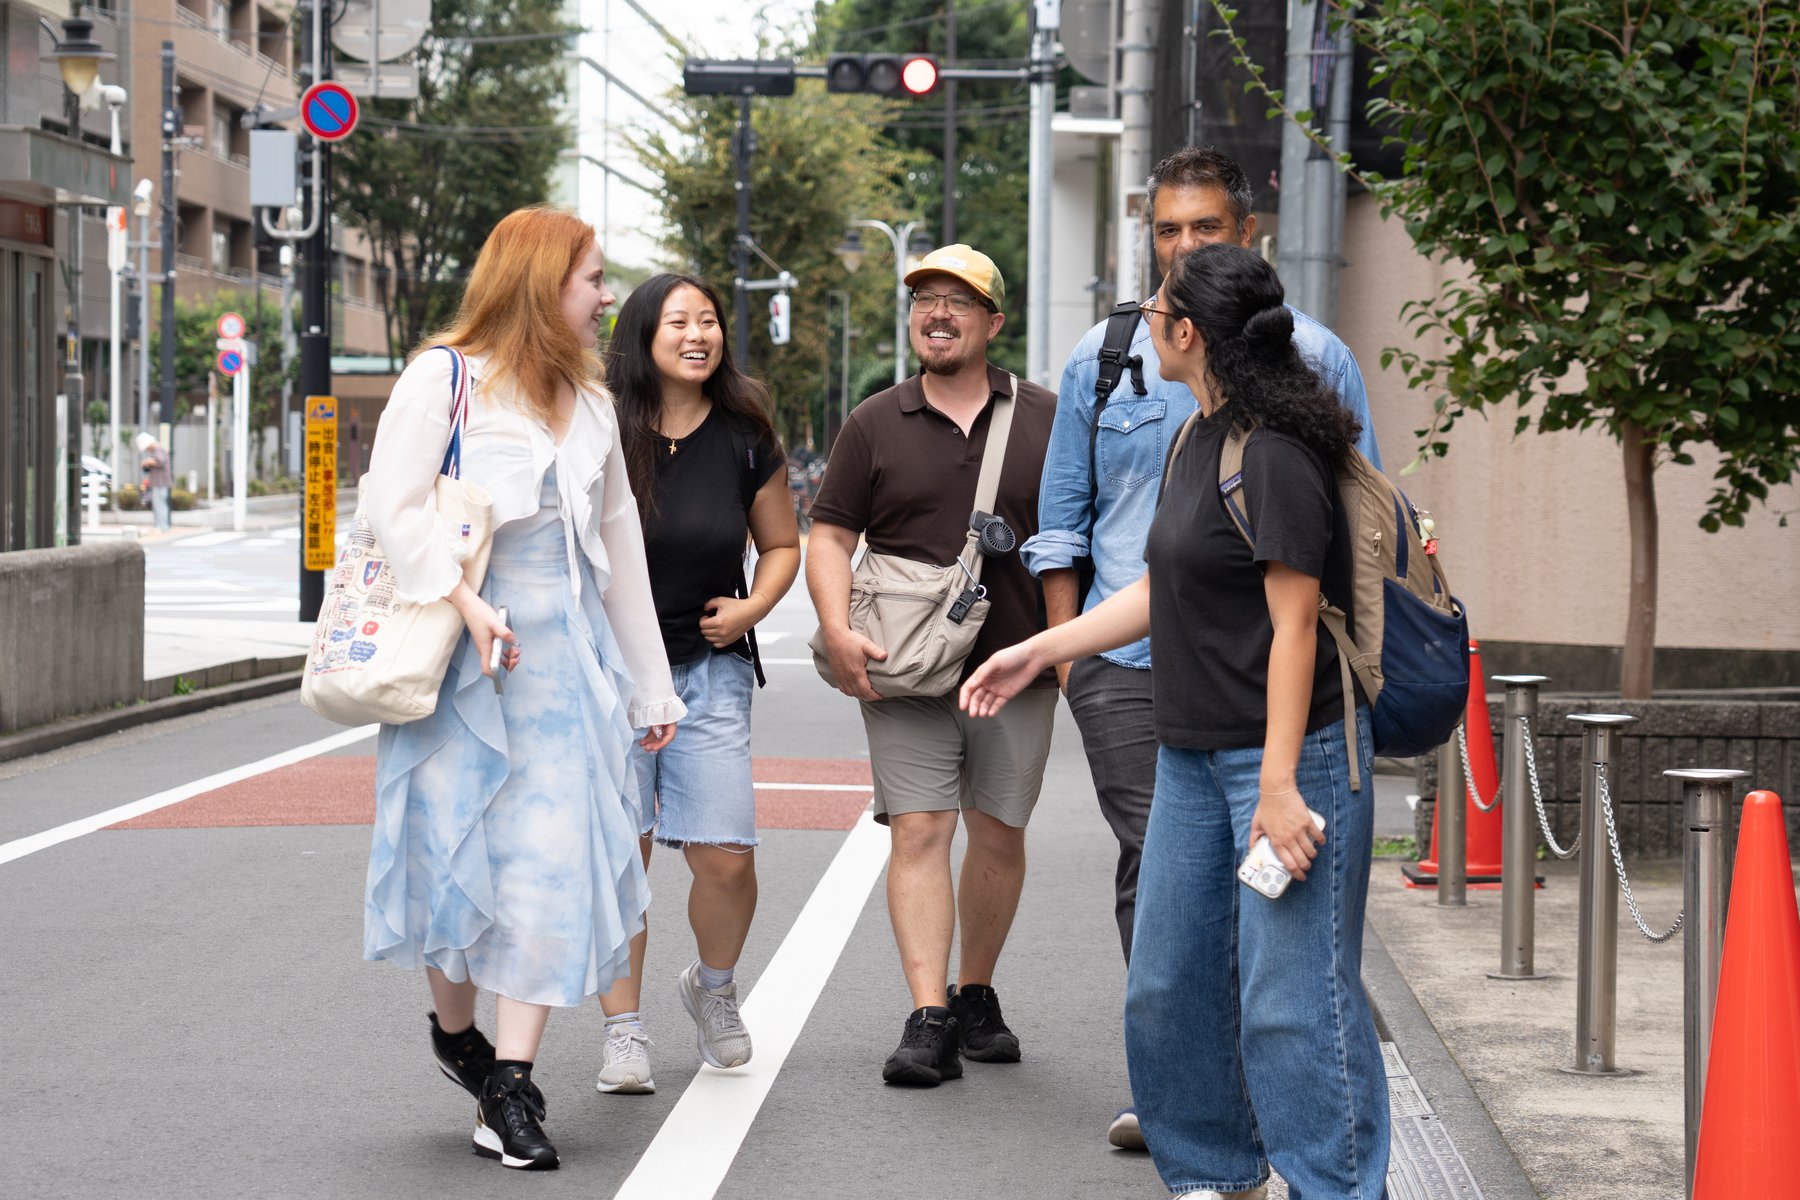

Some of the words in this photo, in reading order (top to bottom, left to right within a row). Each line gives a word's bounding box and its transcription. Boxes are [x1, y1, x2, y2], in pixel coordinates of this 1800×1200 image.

[308, 430, 321, 549] 一時停止・左右確認
